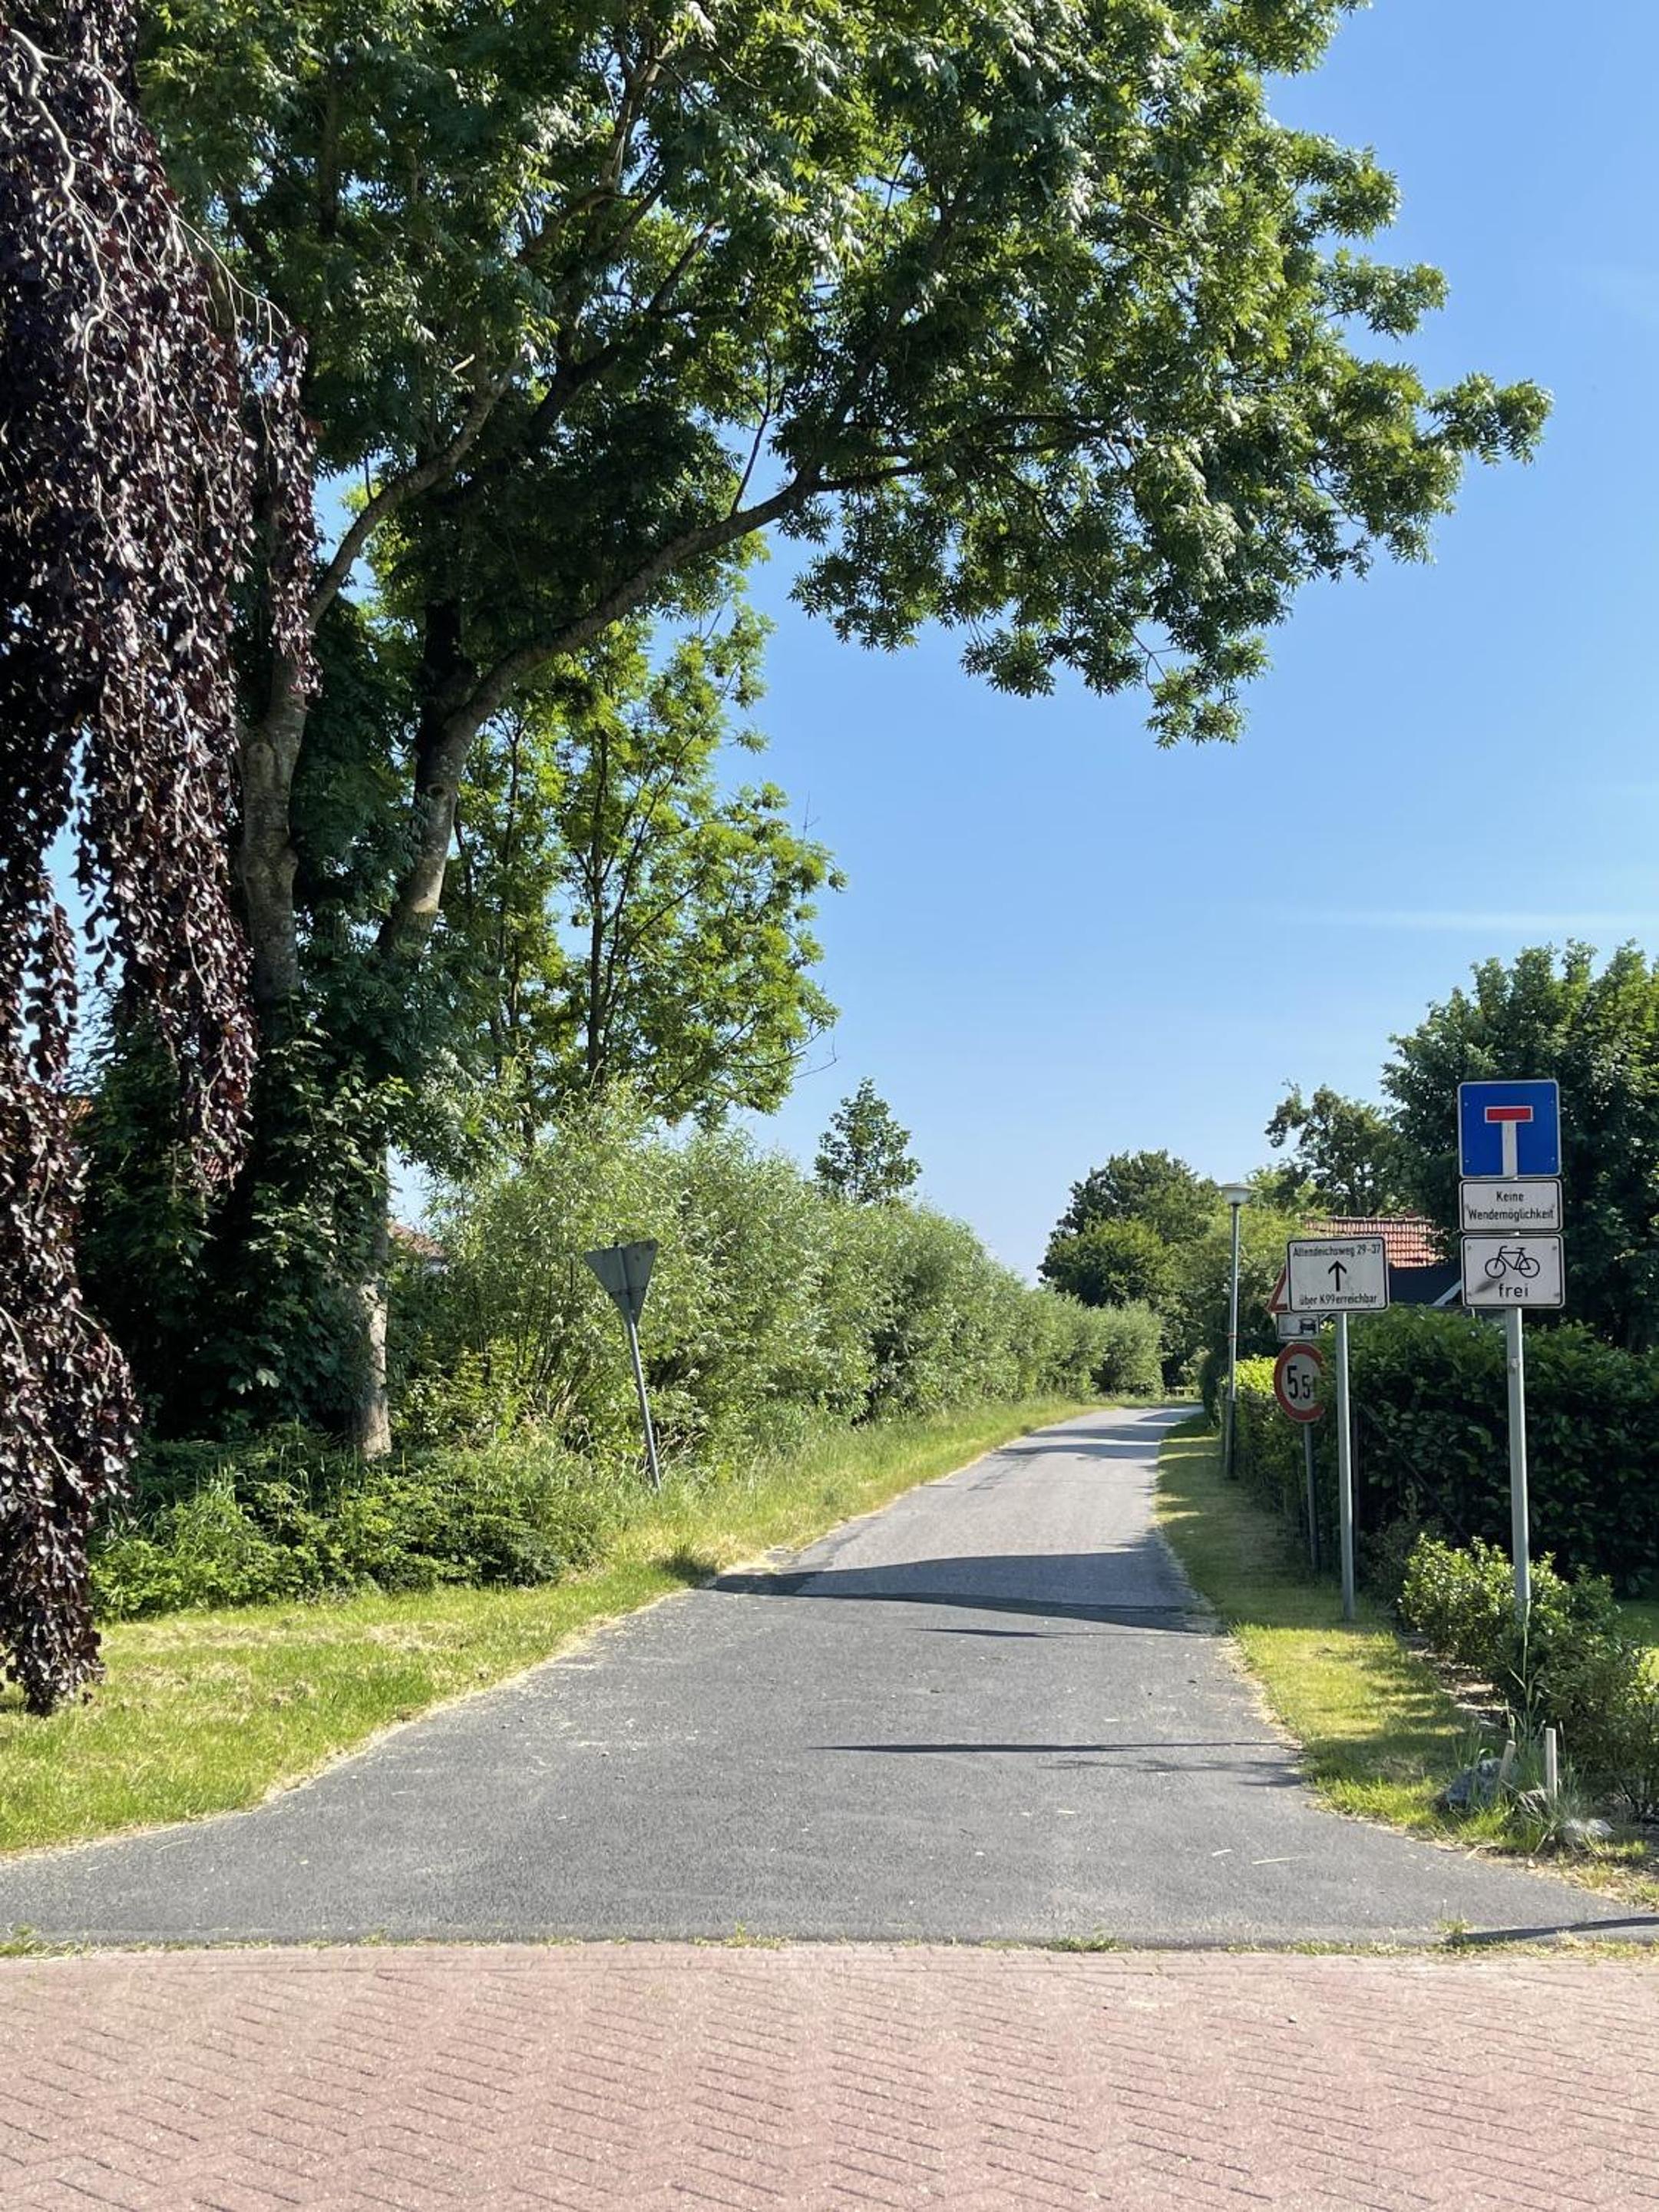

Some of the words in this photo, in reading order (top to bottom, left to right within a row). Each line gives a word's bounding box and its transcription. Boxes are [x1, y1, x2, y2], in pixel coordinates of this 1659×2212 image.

[1496, 1191, 1524, 1202] Keine
[1469, 1208, 1554, 1222] Wendemöglichkeit
[1499, 1283, 1528, 1298] frei
[1299, 1294, 1317, 1305] über
